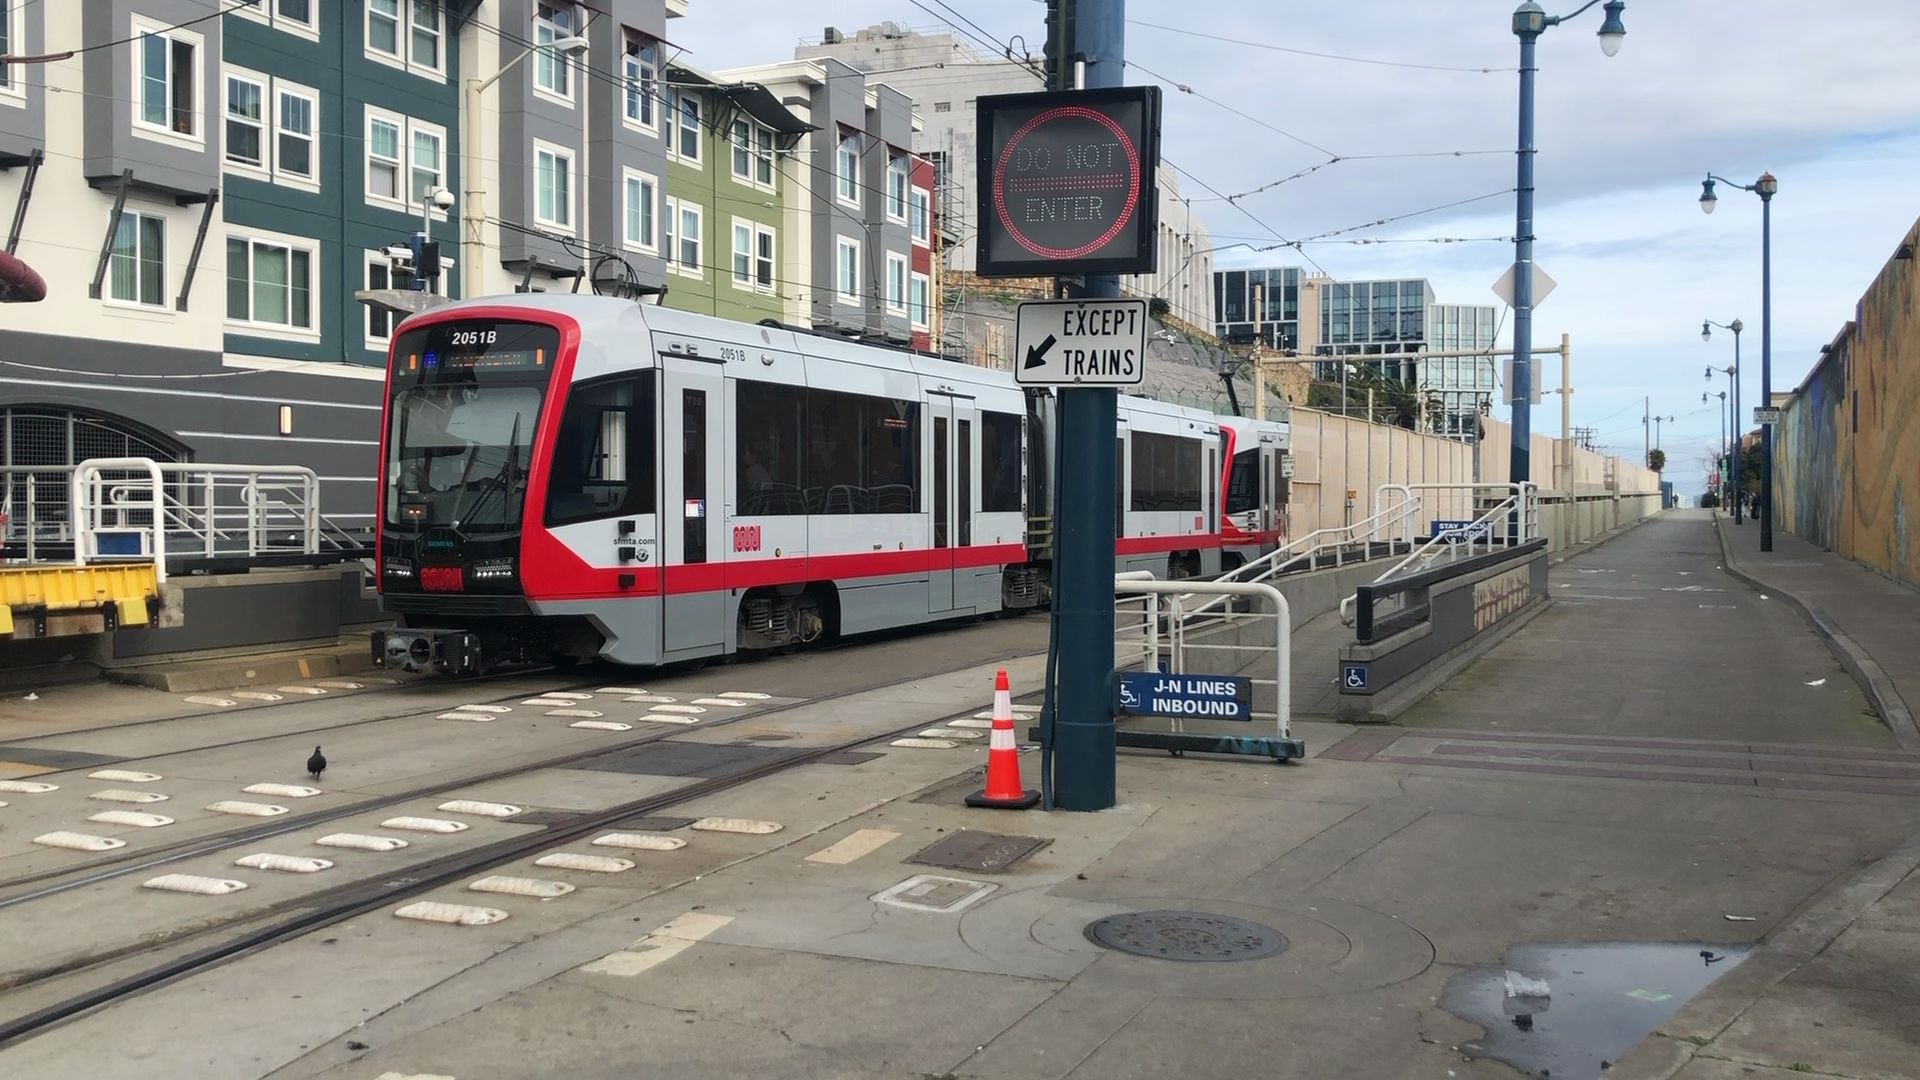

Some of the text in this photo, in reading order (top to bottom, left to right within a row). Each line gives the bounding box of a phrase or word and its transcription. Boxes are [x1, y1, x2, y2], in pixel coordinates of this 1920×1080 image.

[1017, 143, 1119, 171] DO NOT
[1026, 195, 1103, 222] ENTER
[1063, 309, 1138, 336] EXCEPT
[452, 330, 497, 345] 2051B
[720, 347, 746, 362] 2051B
[1063, 349, 1135, 376] TRAINS
[613, 537, 656, 545] sfmta.com
[1154, 679, 1236, 695] J-N LINES
[1152, 698, 1239, 716] INBOUND
